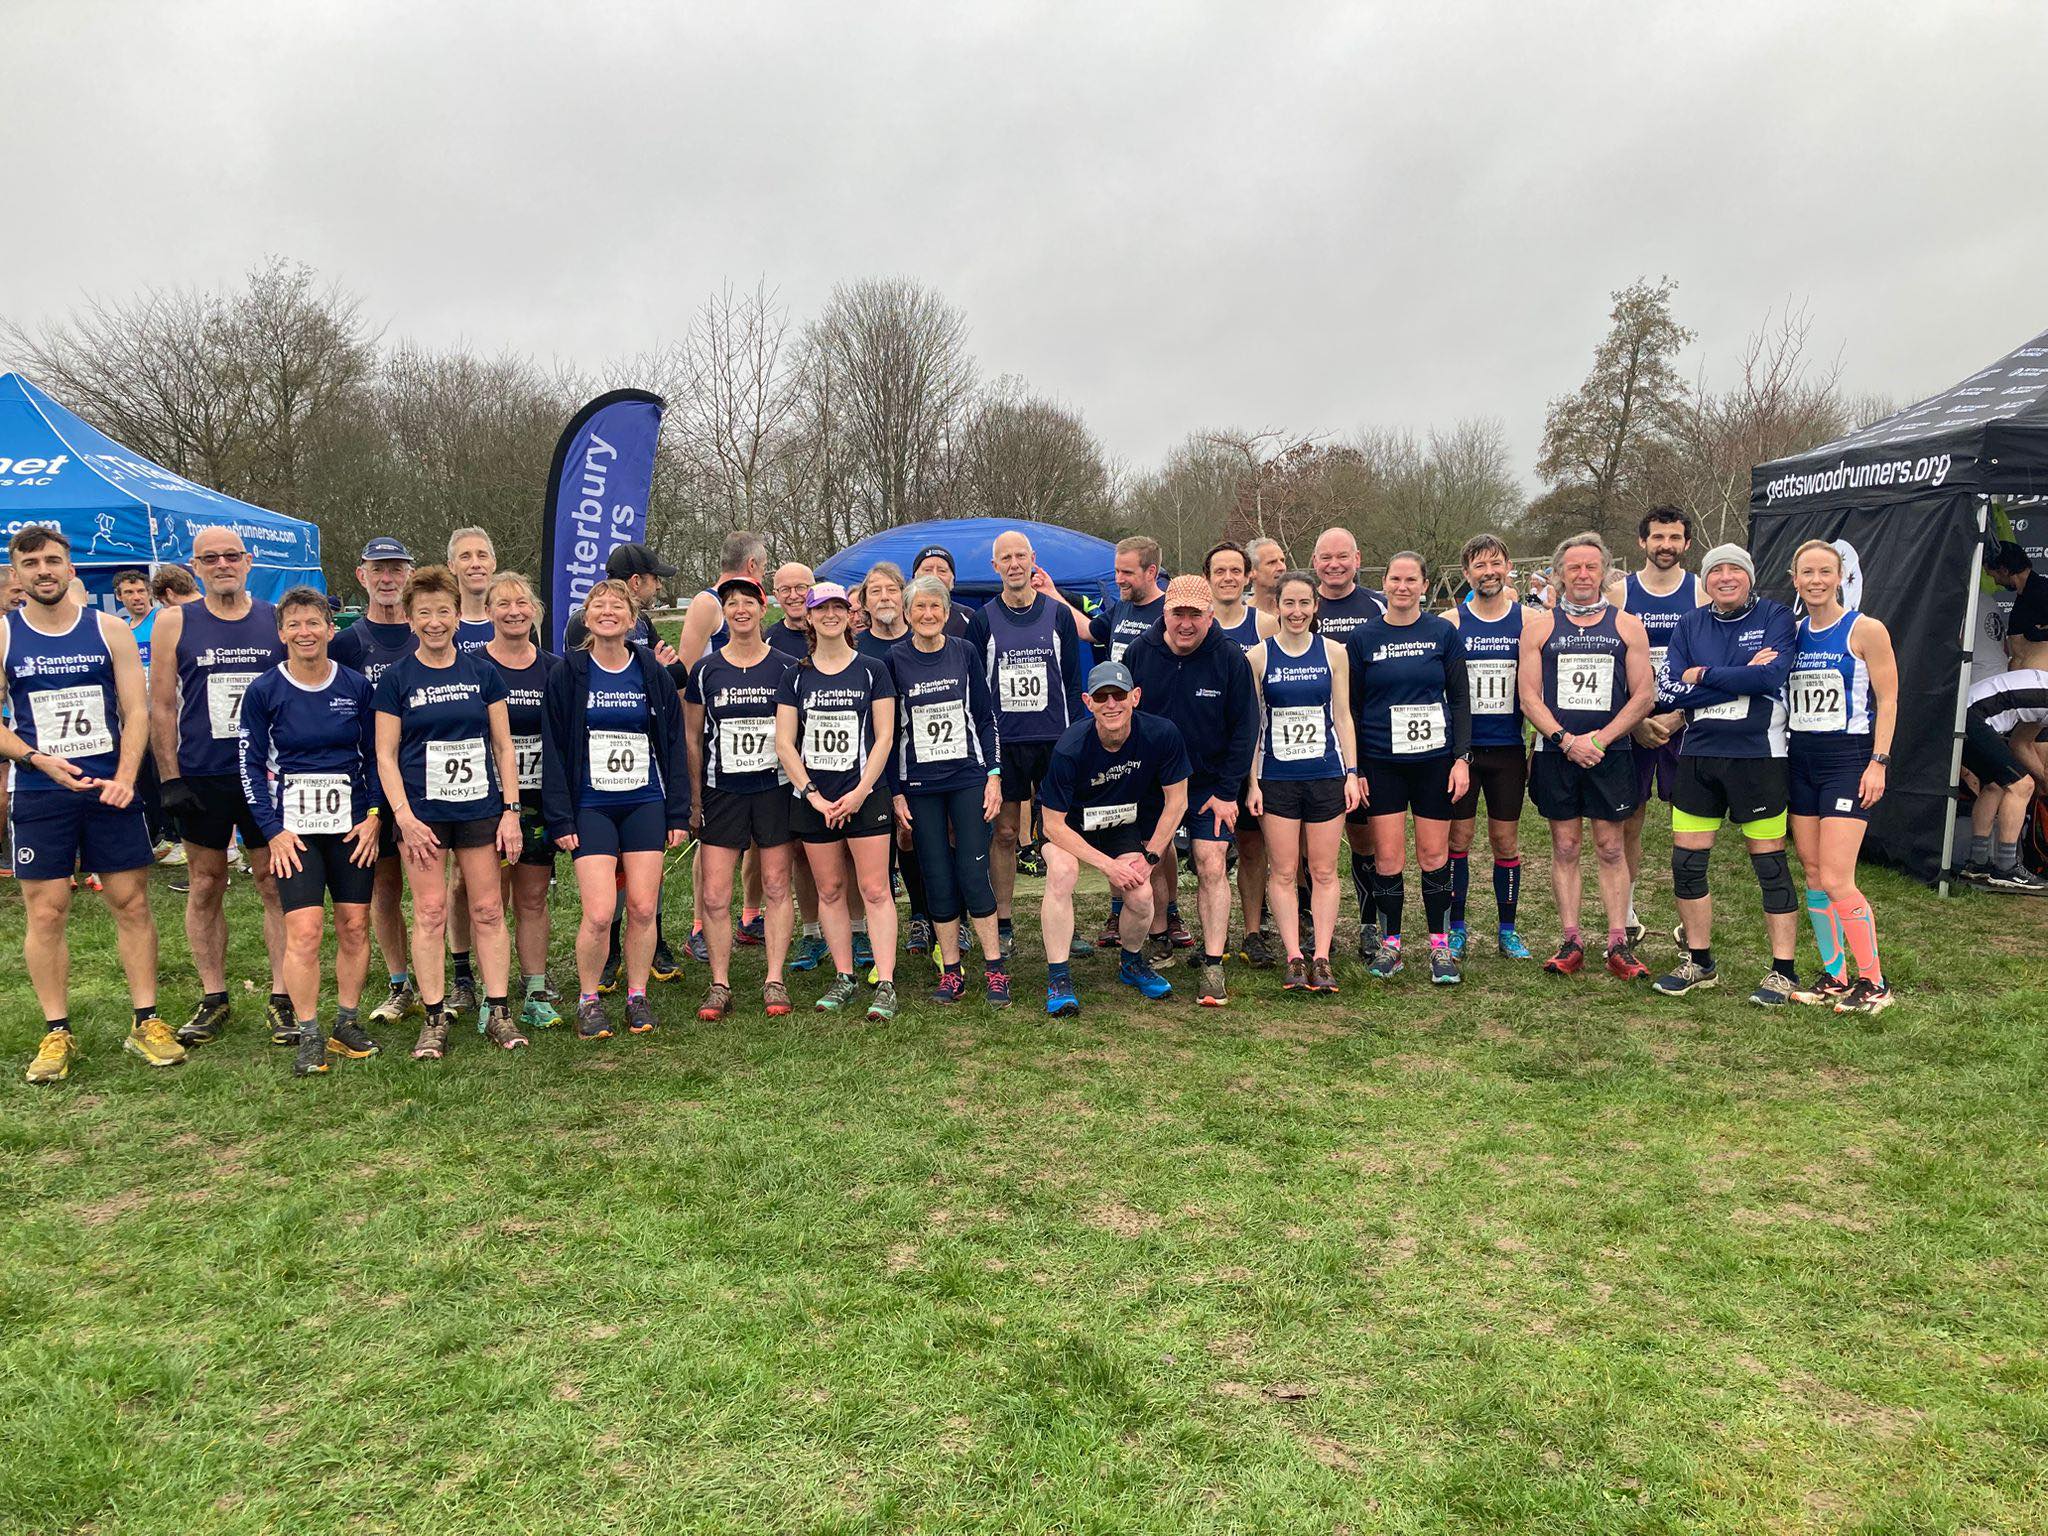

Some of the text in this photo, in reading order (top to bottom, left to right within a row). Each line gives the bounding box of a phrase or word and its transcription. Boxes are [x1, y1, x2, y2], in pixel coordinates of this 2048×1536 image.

[18, 477, 53, 486] AC
[1387, 641, 1437, 651] Canterbury
[1567, 635, 1621, 647] Canterbury
[214, 647, 272, 657] Canterbury
[1008, 648, 1054, 657] Canterbury
[1388, 649, 1424, 659] Harriers
[1798, 651, 1844, 661] Canterbury
[36, 653, 105, 666] Canterbury
[216, 656, 257, 664] Harriers
[1010, 656, 1043, 664] Harriers
[1796, 659, 1828, 668] Harriers
[37, 663, 90, 675] Harriers
[1283, 666, 1328, 676] Canterbury
[921, 678, 959, 689] Canterbury
[1009, 676, 1041, 698] 130
[1476, 677, 1506, 698] 111
[1572, 671, 1598, 693] 94
[426, 682, 480, 695] Canterbury
[509, 689, 543, 698] anterbu
[729, 686, 777, 696] Canterbur
[921, 684, 951, 695] Harriers
[33, 690, 101, 704] KENT FITNESS LEAGUE
[428, 691, 470, 704] Harriers
[730, 695, 768, 704] Harriers
[817, 689, 865, 700] Canterbury
[228, 693, 243, 719] 7
[597, 699, 638, 708] Harriers
[817, 698, 854, 707] Harriers
[1568, 697, 1602, 705] Colin K
[1793, 688, 1840, 714] 1122
[1702, 706, 1736, 716] Andy F
[55, 709, 92, 739] 76
[927, 720, 953, 744] 92
[1282, 723, 1317, 745] 122
[1407, 719, 1432, 741] 83
[48, 738, 107, 755] Michael F
[733, 732, 768, 756] 107
[814, 729, 850, 753] 108
[443, 743, 466, 751] FITNESS
[929, 748, 949, 756] Tina
[1285, 748, 1307, 756] Sara
[518, 751, 541, 775] 17
[606, 749, 635, 773] 60
[757, 757, 764, 766] P
[813, 757, 848, 766] Emily P
[238, 739, 258, 805] Canterbury
[444, 758, 473, 784] 95
[595, 777, 640, 786] Kimberley
[440, 787, 478, 798] Nicky L
[299, 788, 340, 815] 110
[296, 819, 341, 829] Claire P
